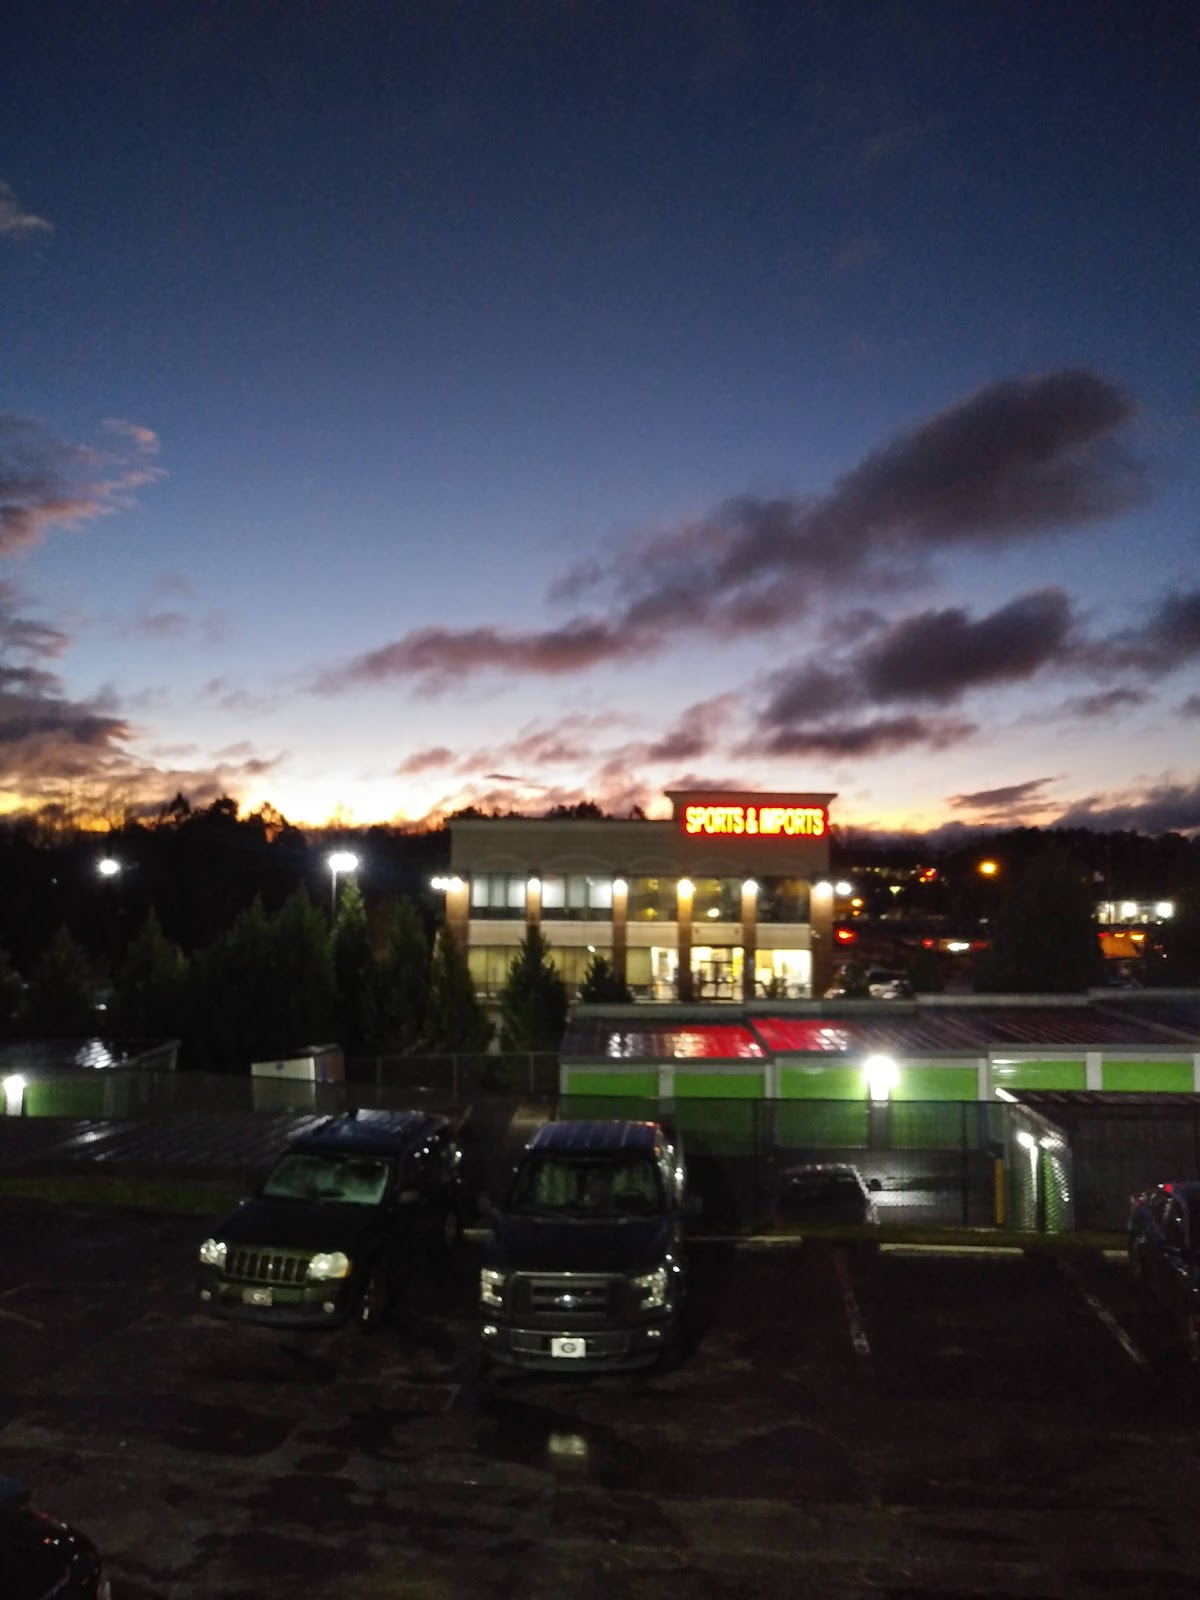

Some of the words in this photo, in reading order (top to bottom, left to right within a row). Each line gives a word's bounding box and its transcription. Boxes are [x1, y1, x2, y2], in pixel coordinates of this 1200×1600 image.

[685, 806, 745, 834] SPORTS
[746, 806, 759, 835] &
[759, 807, 825, 836] IMPORTS
